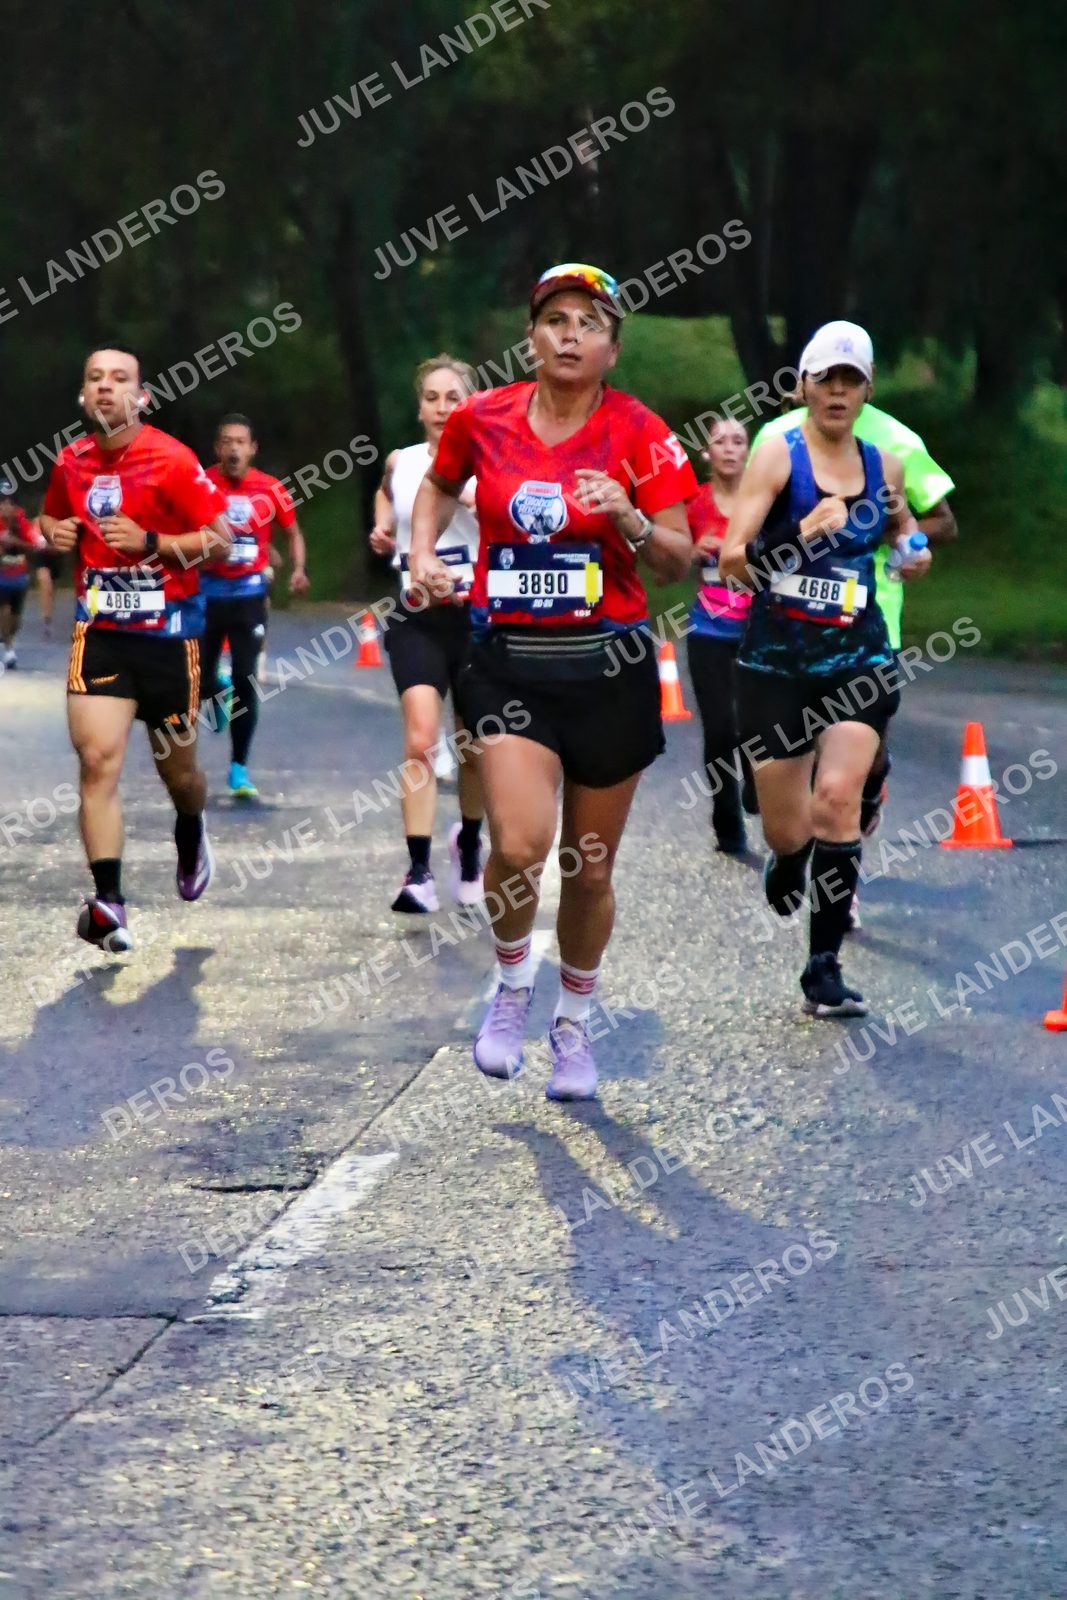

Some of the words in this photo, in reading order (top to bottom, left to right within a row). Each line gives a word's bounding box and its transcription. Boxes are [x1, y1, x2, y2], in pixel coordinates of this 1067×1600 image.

[518, 572, 568, 595] 3890
[798, 577, 841, 601] 4688
[106, 592, 141, 609] 4863
